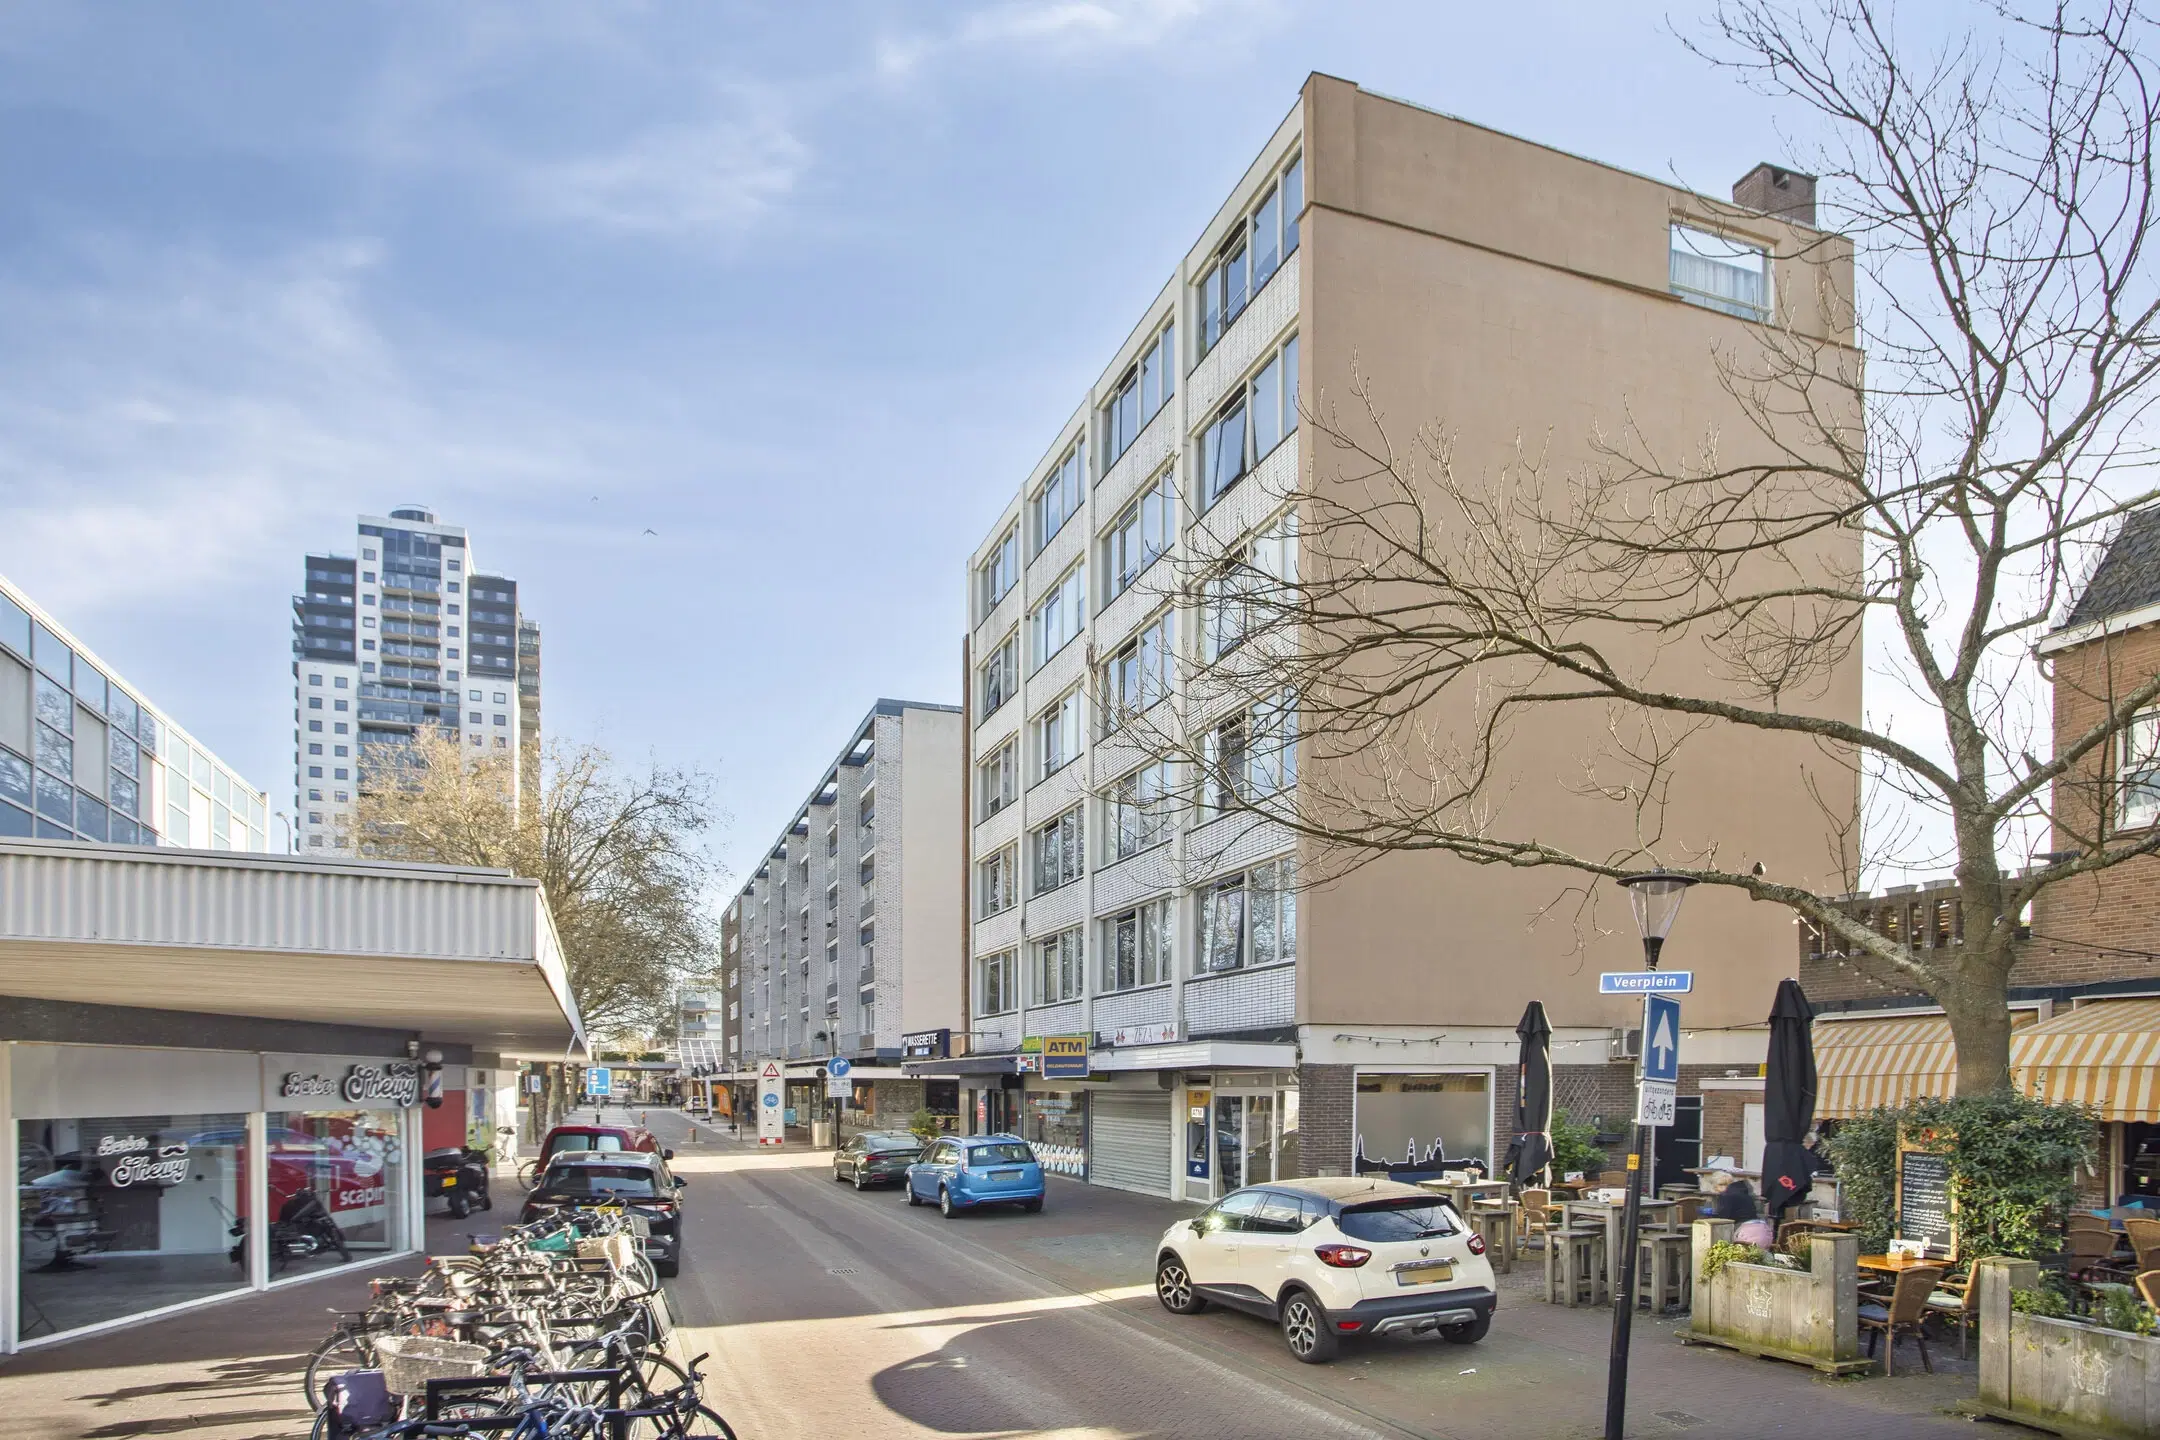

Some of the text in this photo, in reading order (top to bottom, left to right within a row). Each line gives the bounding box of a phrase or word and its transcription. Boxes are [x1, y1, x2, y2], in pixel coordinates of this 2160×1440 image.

[1613, 975, 1677, 990] Veerplein
[1133, 1026, 1154, 1044] ZEZA
[1048, 1041, 1083, 1053] ATM
[283, 1072, 338, 1097] Barber
[97, 1134, 150, 1157] Barber
